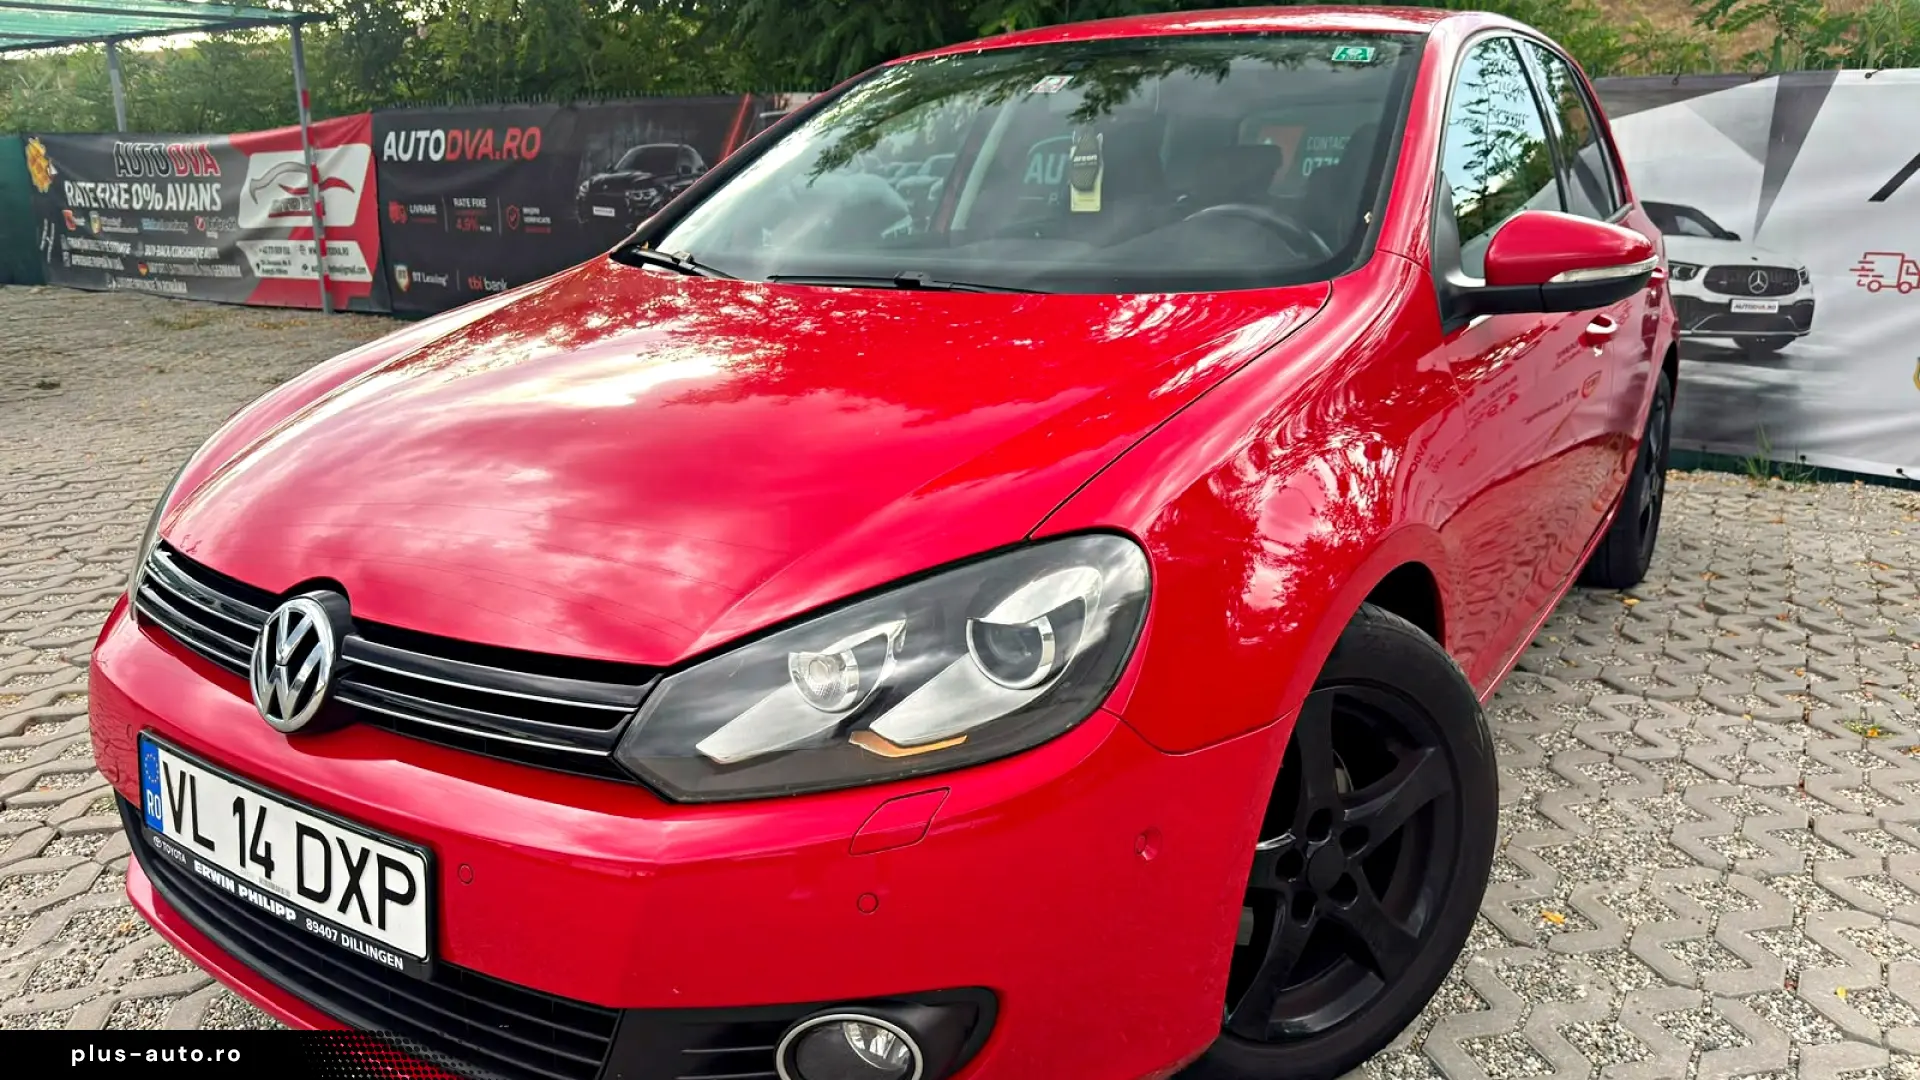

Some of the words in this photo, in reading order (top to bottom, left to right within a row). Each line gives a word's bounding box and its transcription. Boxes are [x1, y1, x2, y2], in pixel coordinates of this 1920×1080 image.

[383, 126, 542, 162] AUTODVA.RO
[64, 180, 98, 208] RATE
[96, 182, 130, 210] FIXE
[131, 183, 163, 211] 0%
[165, 183, 222, 211] AVANS
[146, 789, 162, 821] RO
[162, 761, 215, 851] VL
[232, 796, 275, 880] 14
[295, 821, 417, 931] DXP
[161, 841, 187, 865] TOYOTA
[193, 860, 235, 893] ERWIN
[238, 884, 297, 921] PHILIPP
[305, 917, 338, 942] 89407
[341, 933, 404, 971] DILLINGEN
